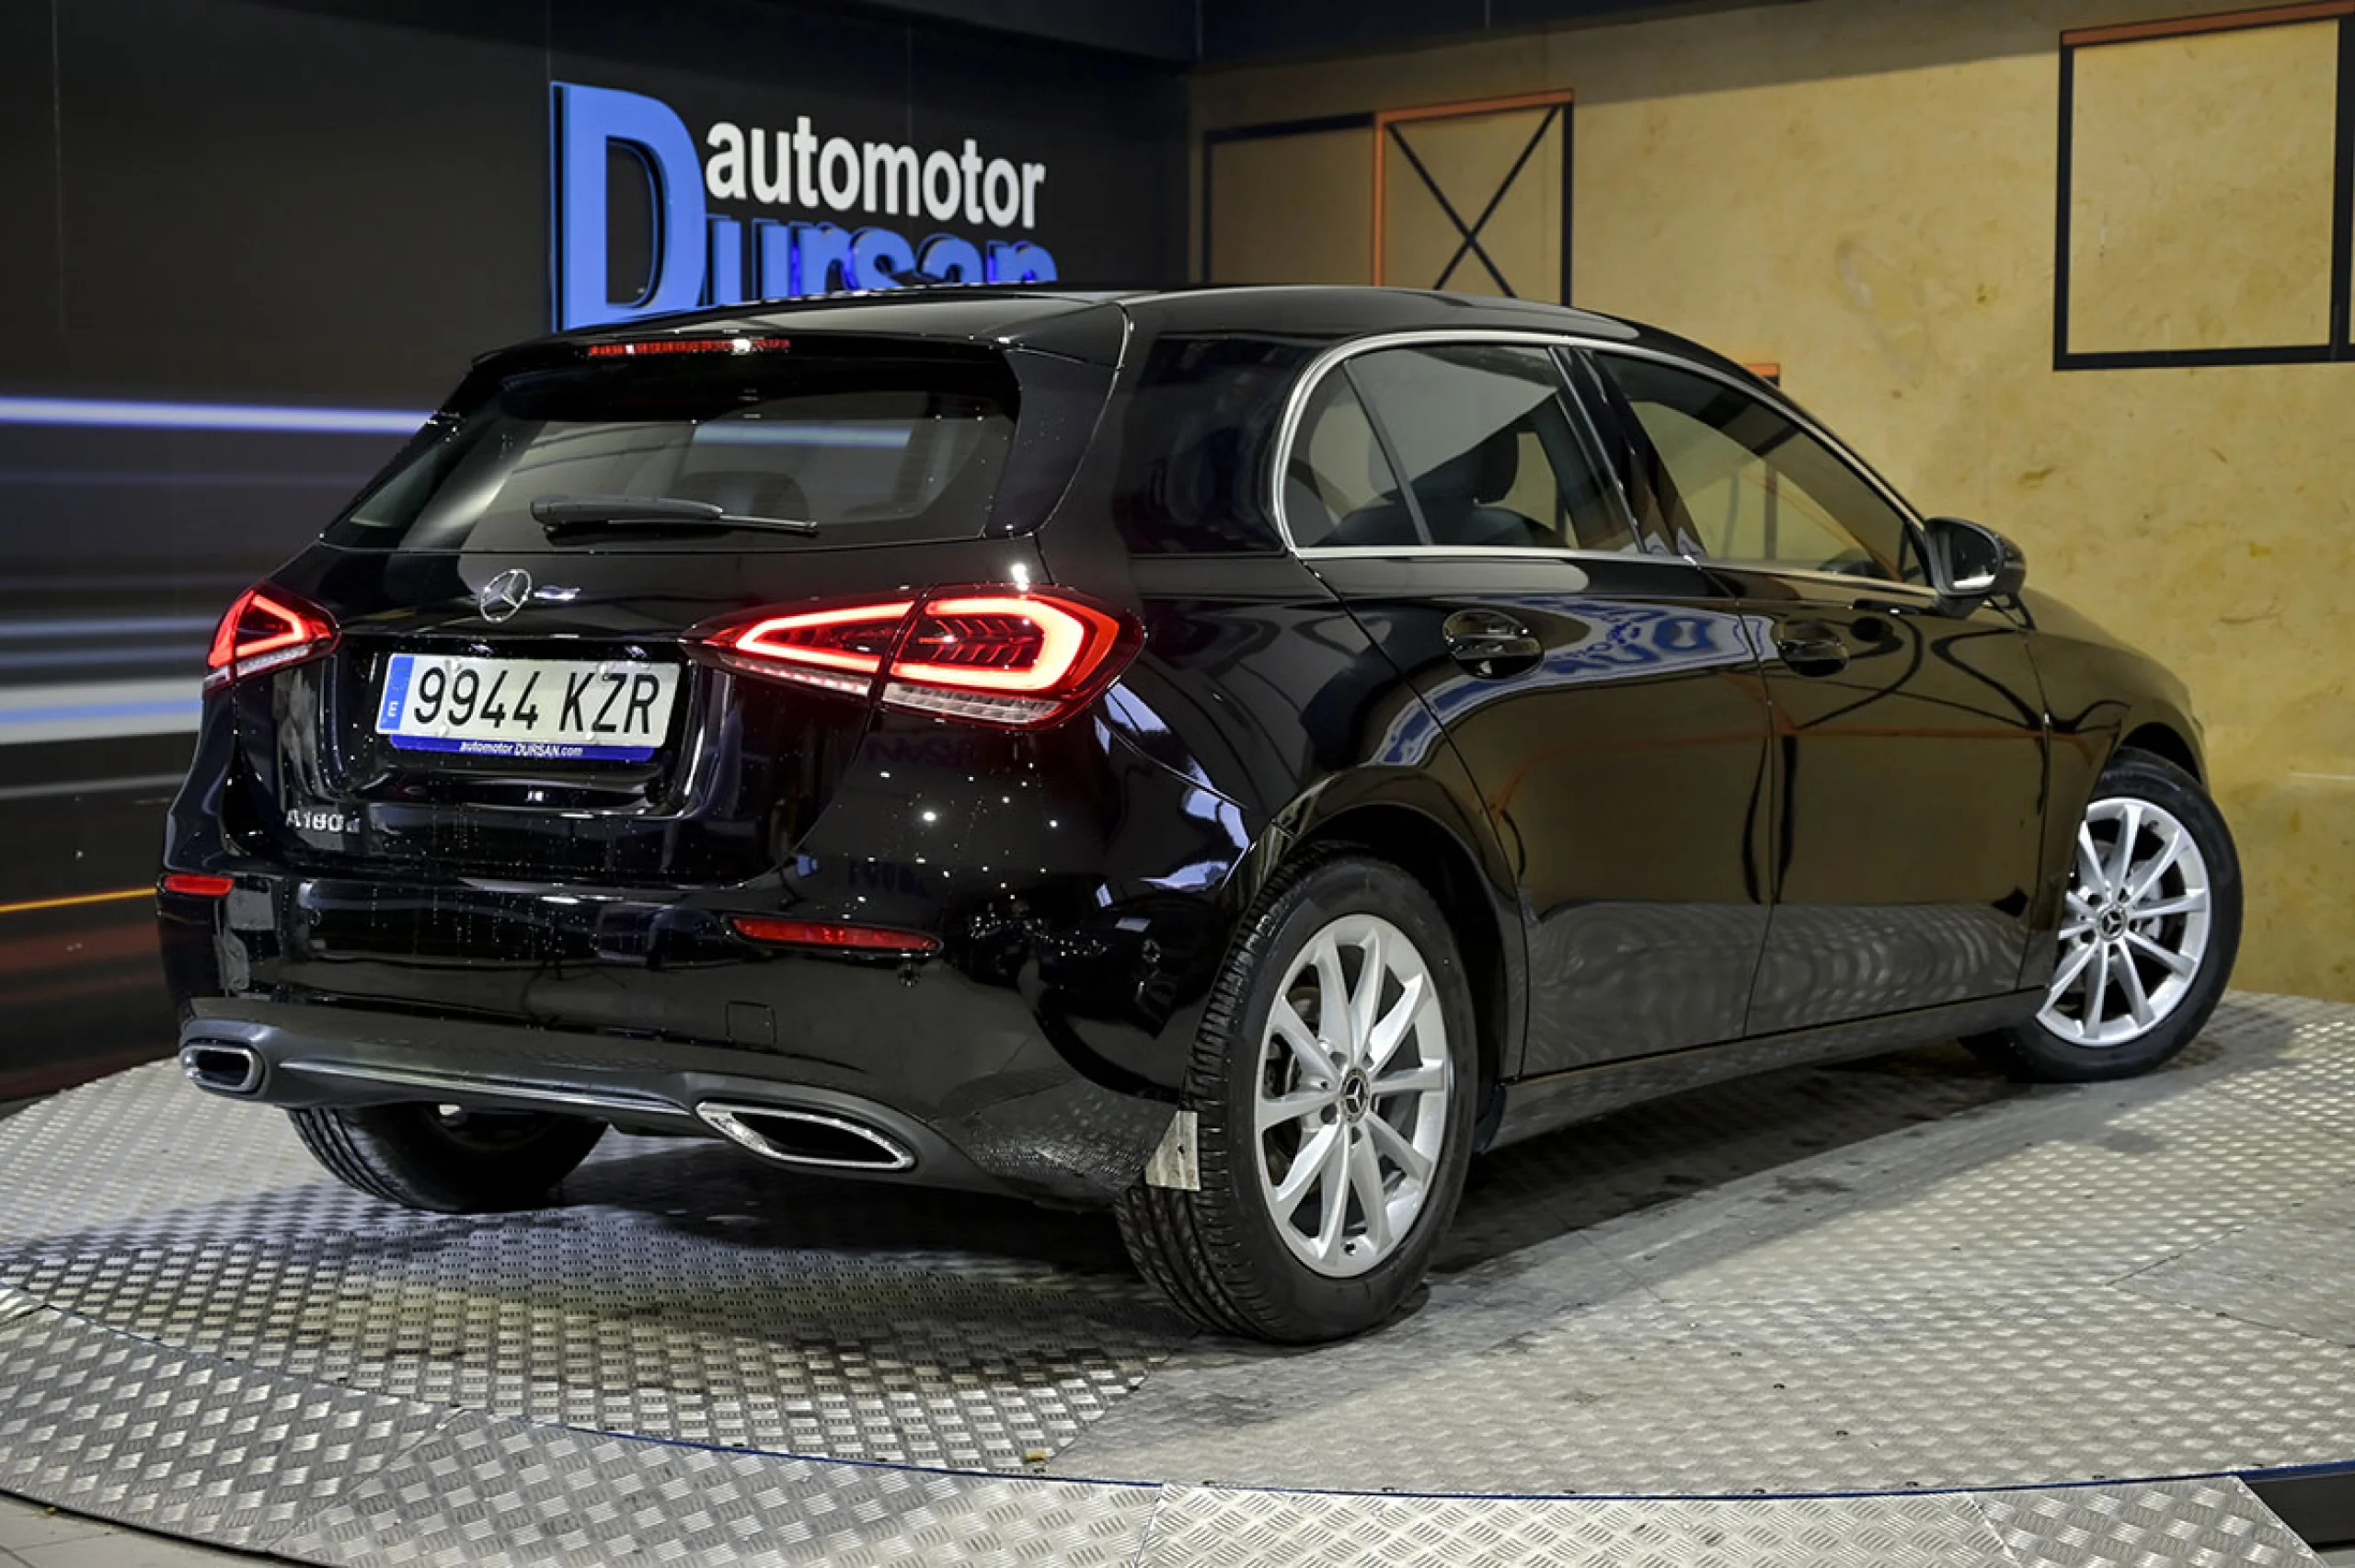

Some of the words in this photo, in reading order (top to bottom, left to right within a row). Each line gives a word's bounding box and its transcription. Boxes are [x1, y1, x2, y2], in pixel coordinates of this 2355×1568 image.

[706, 116, 1046, 229] automotor
[387, 701, 398, 717] E
[413, 667, 541, 730] 9944
[558, 671, 661, 735] KZR
[459, 741, 514, 755] automotor
